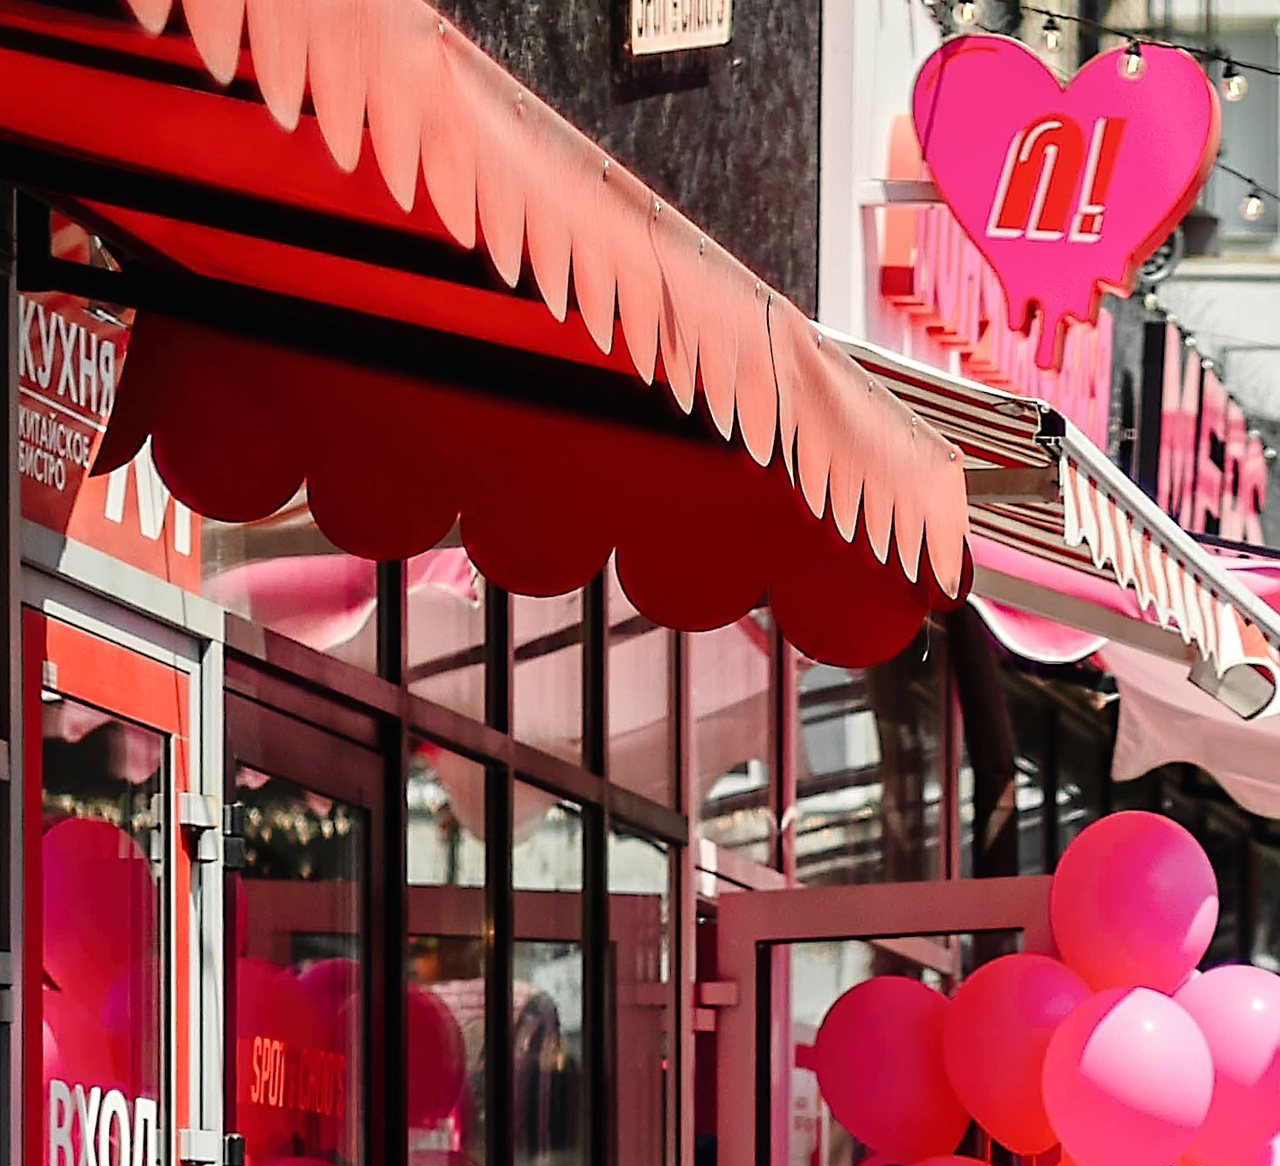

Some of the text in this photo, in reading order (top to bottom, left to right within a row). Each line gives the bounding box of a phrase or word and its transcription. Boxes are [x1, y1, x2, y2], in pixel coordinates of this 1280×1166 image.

[19, 295, 116, 417] КУХНЯ
[19, 404, 90, 469] КИТАЙСКОЕ
[19, 441, 66, 491] БИСТРО
